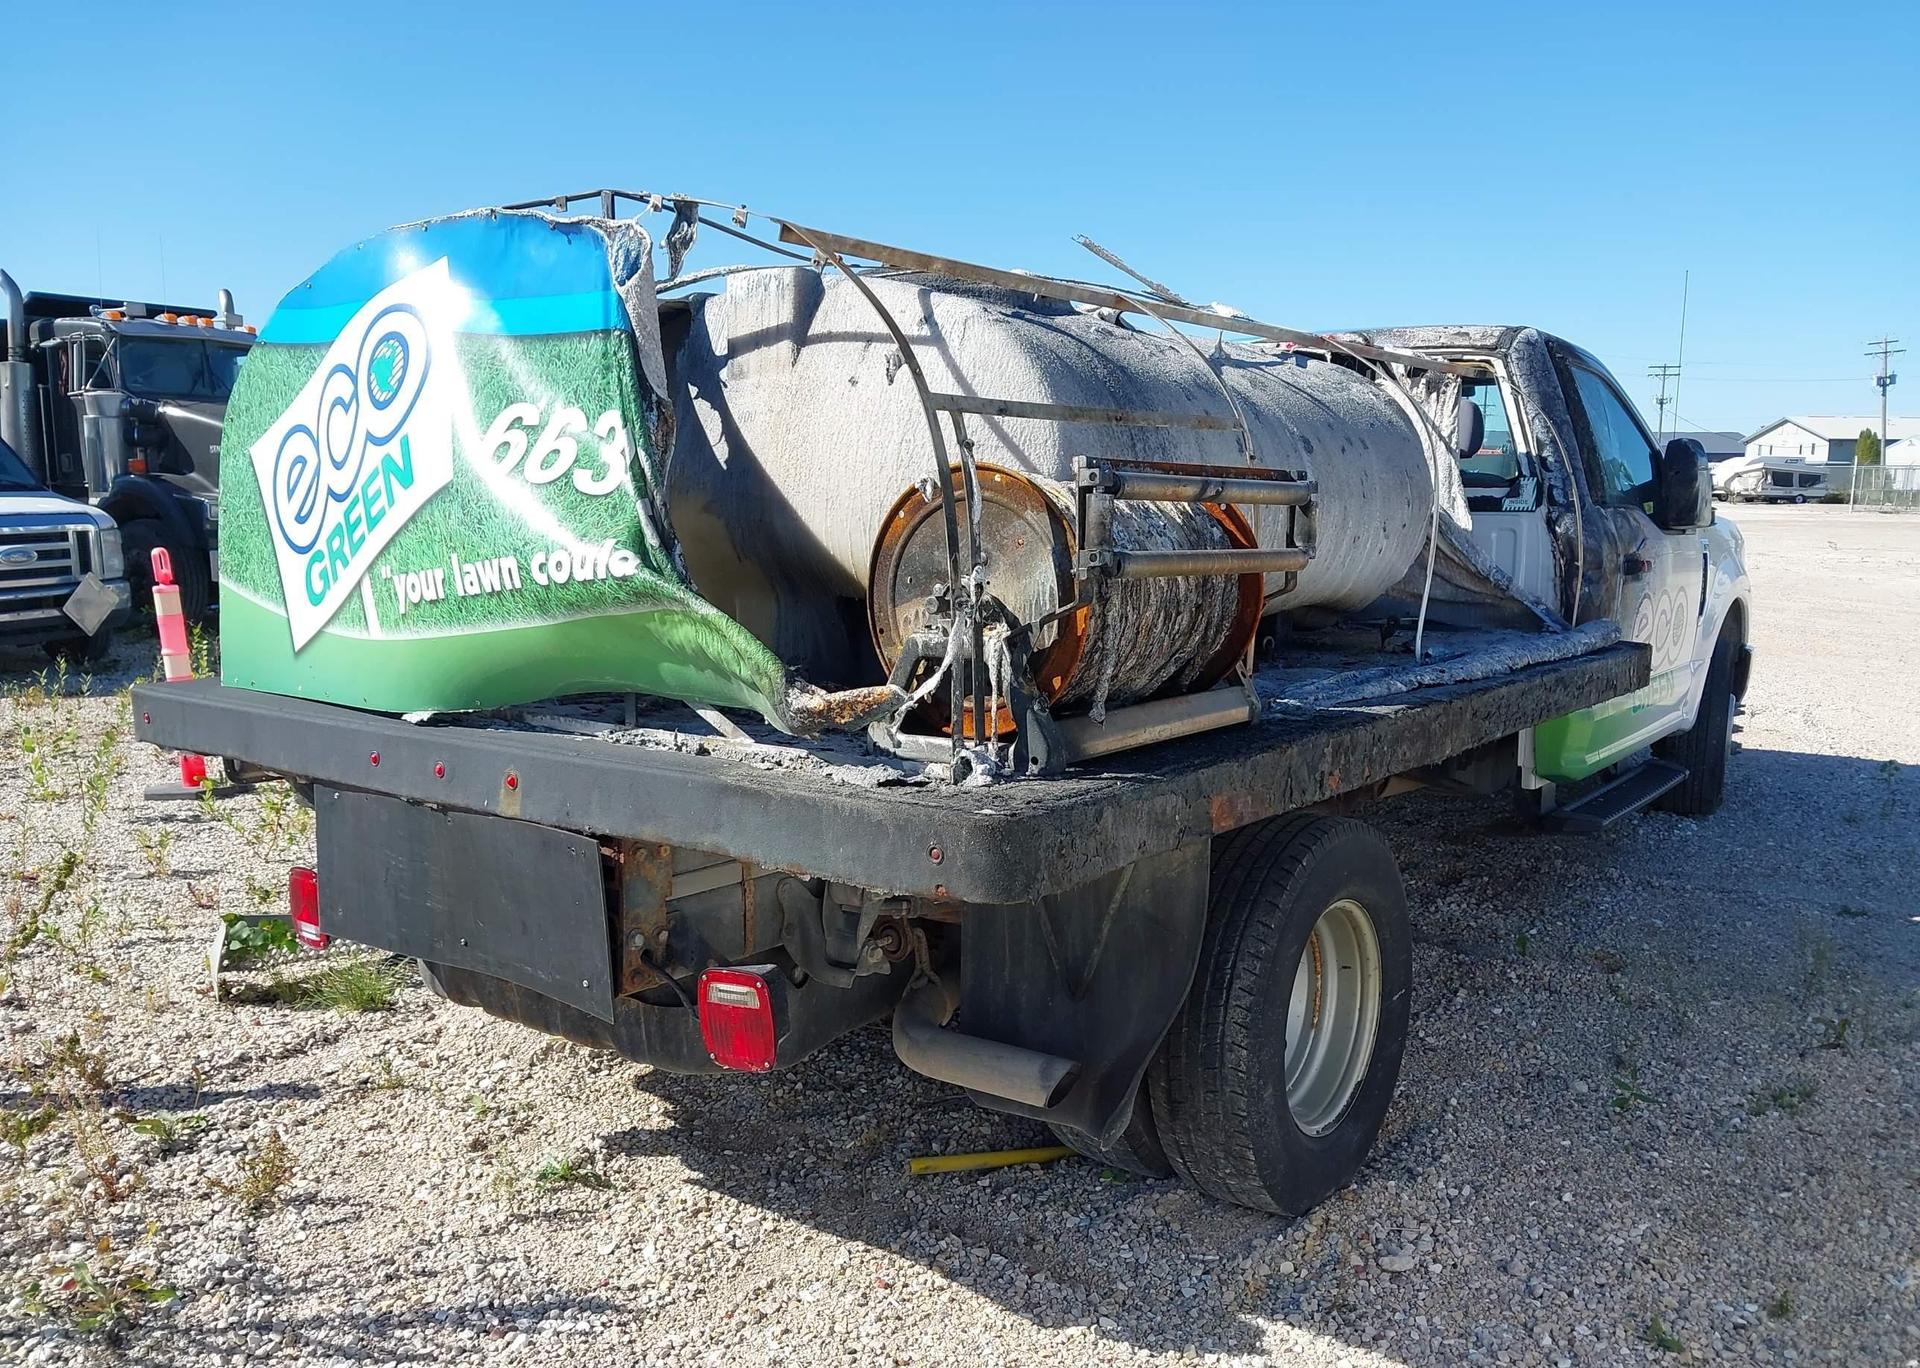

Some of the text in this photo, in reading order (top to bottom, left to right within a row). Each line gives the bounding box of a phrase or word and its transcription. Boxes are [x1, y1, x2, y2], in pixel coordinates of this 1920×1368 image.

[272, 303, 430, 554] eco
[480, 402, 628, 496] 663
[305, 436, 413, 607] GREEN
[451, 553, 522, 597] lawn
